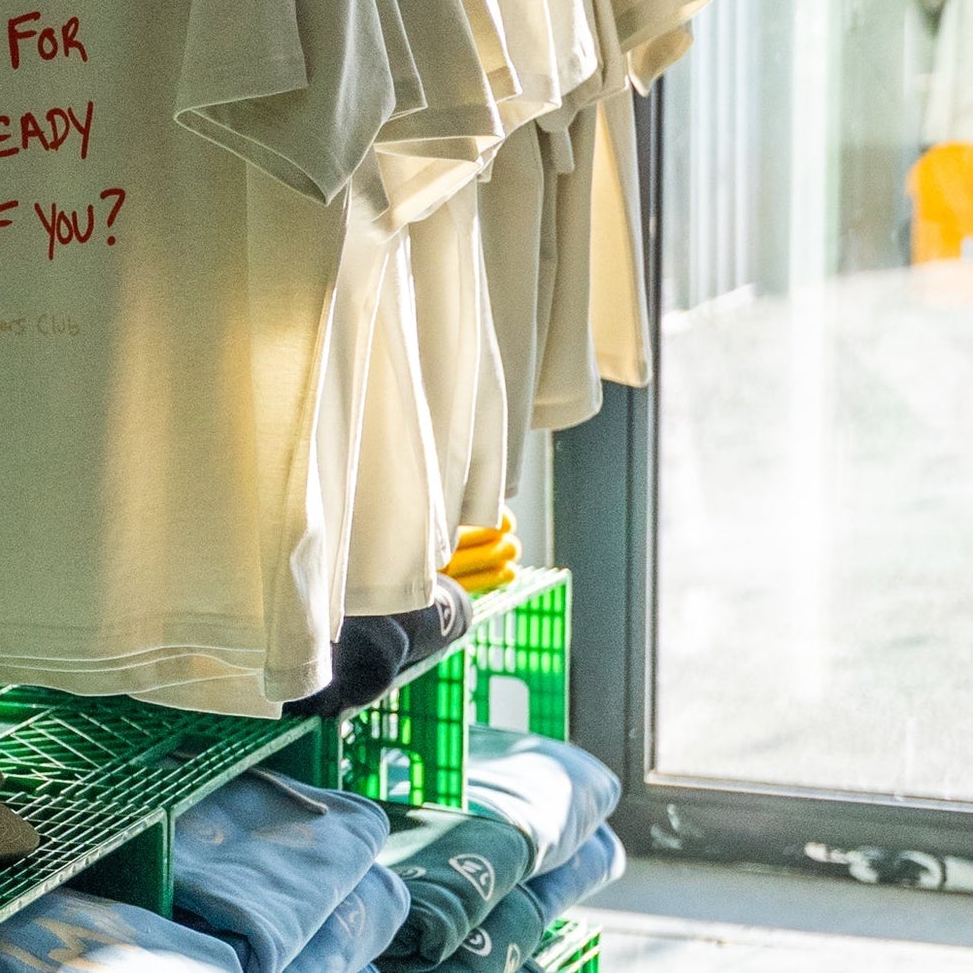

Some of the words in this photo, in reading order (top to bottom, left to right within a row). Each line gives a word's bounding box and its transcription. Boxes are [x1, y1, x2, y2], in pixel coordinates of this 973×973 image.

[7, 11, 88, 69] FOR
[34, 187, 126, 260] YOU?
[37, 312, 82, 338] Club
